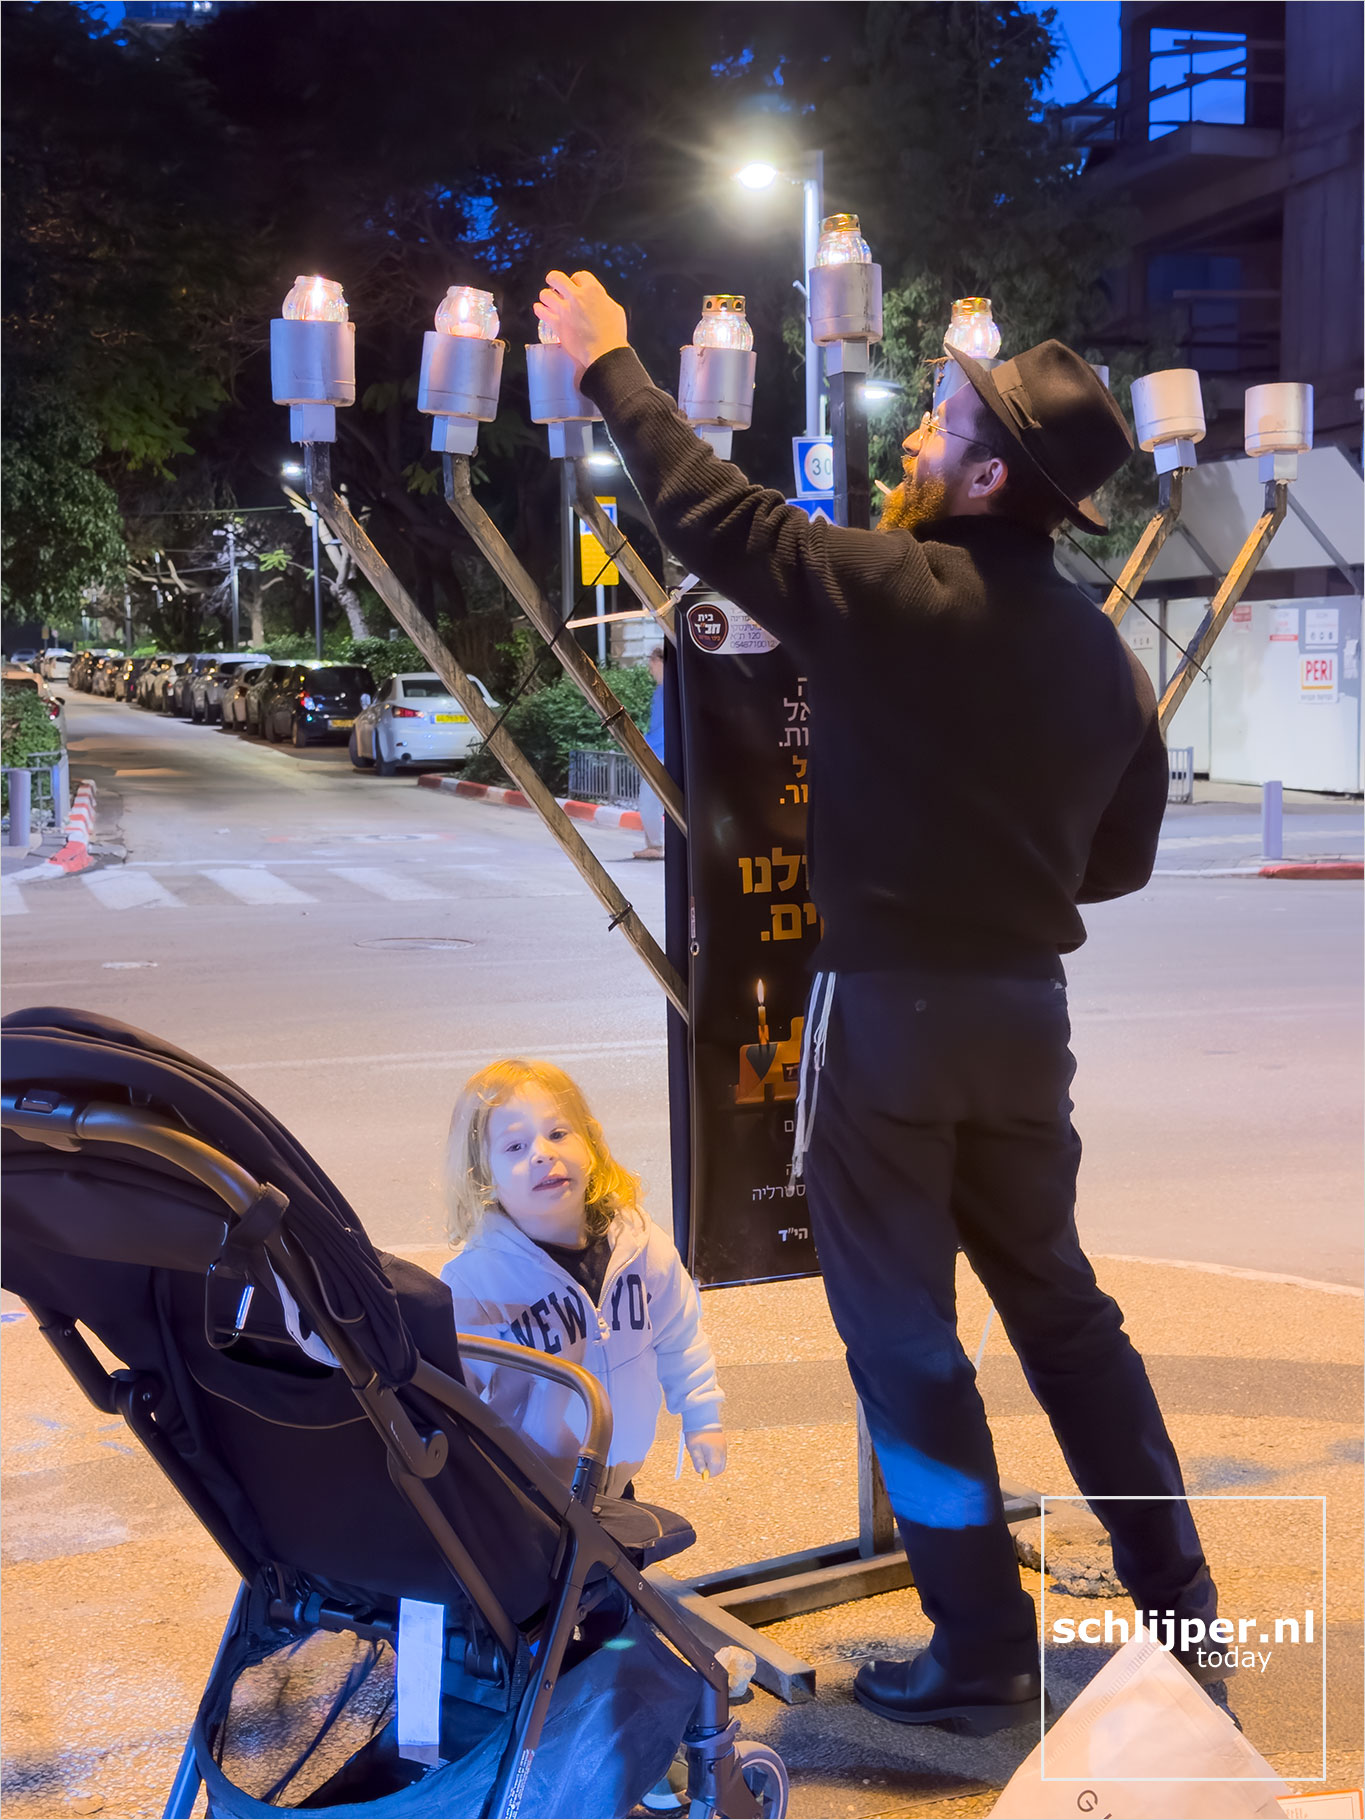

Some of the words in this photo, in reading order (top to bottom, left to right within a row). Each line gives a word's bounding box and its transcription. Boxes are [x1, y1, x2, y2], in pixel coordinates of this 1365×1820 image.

[812, 458, 832, 476] 30
[697, 613, 714, 622] בית
[748, 632, 761, 640] 120
[1305, 659, 1333, 682] PERI
[511, 1285, 587, 1355] NEW
[611, 1273, 653, 1331] YO
